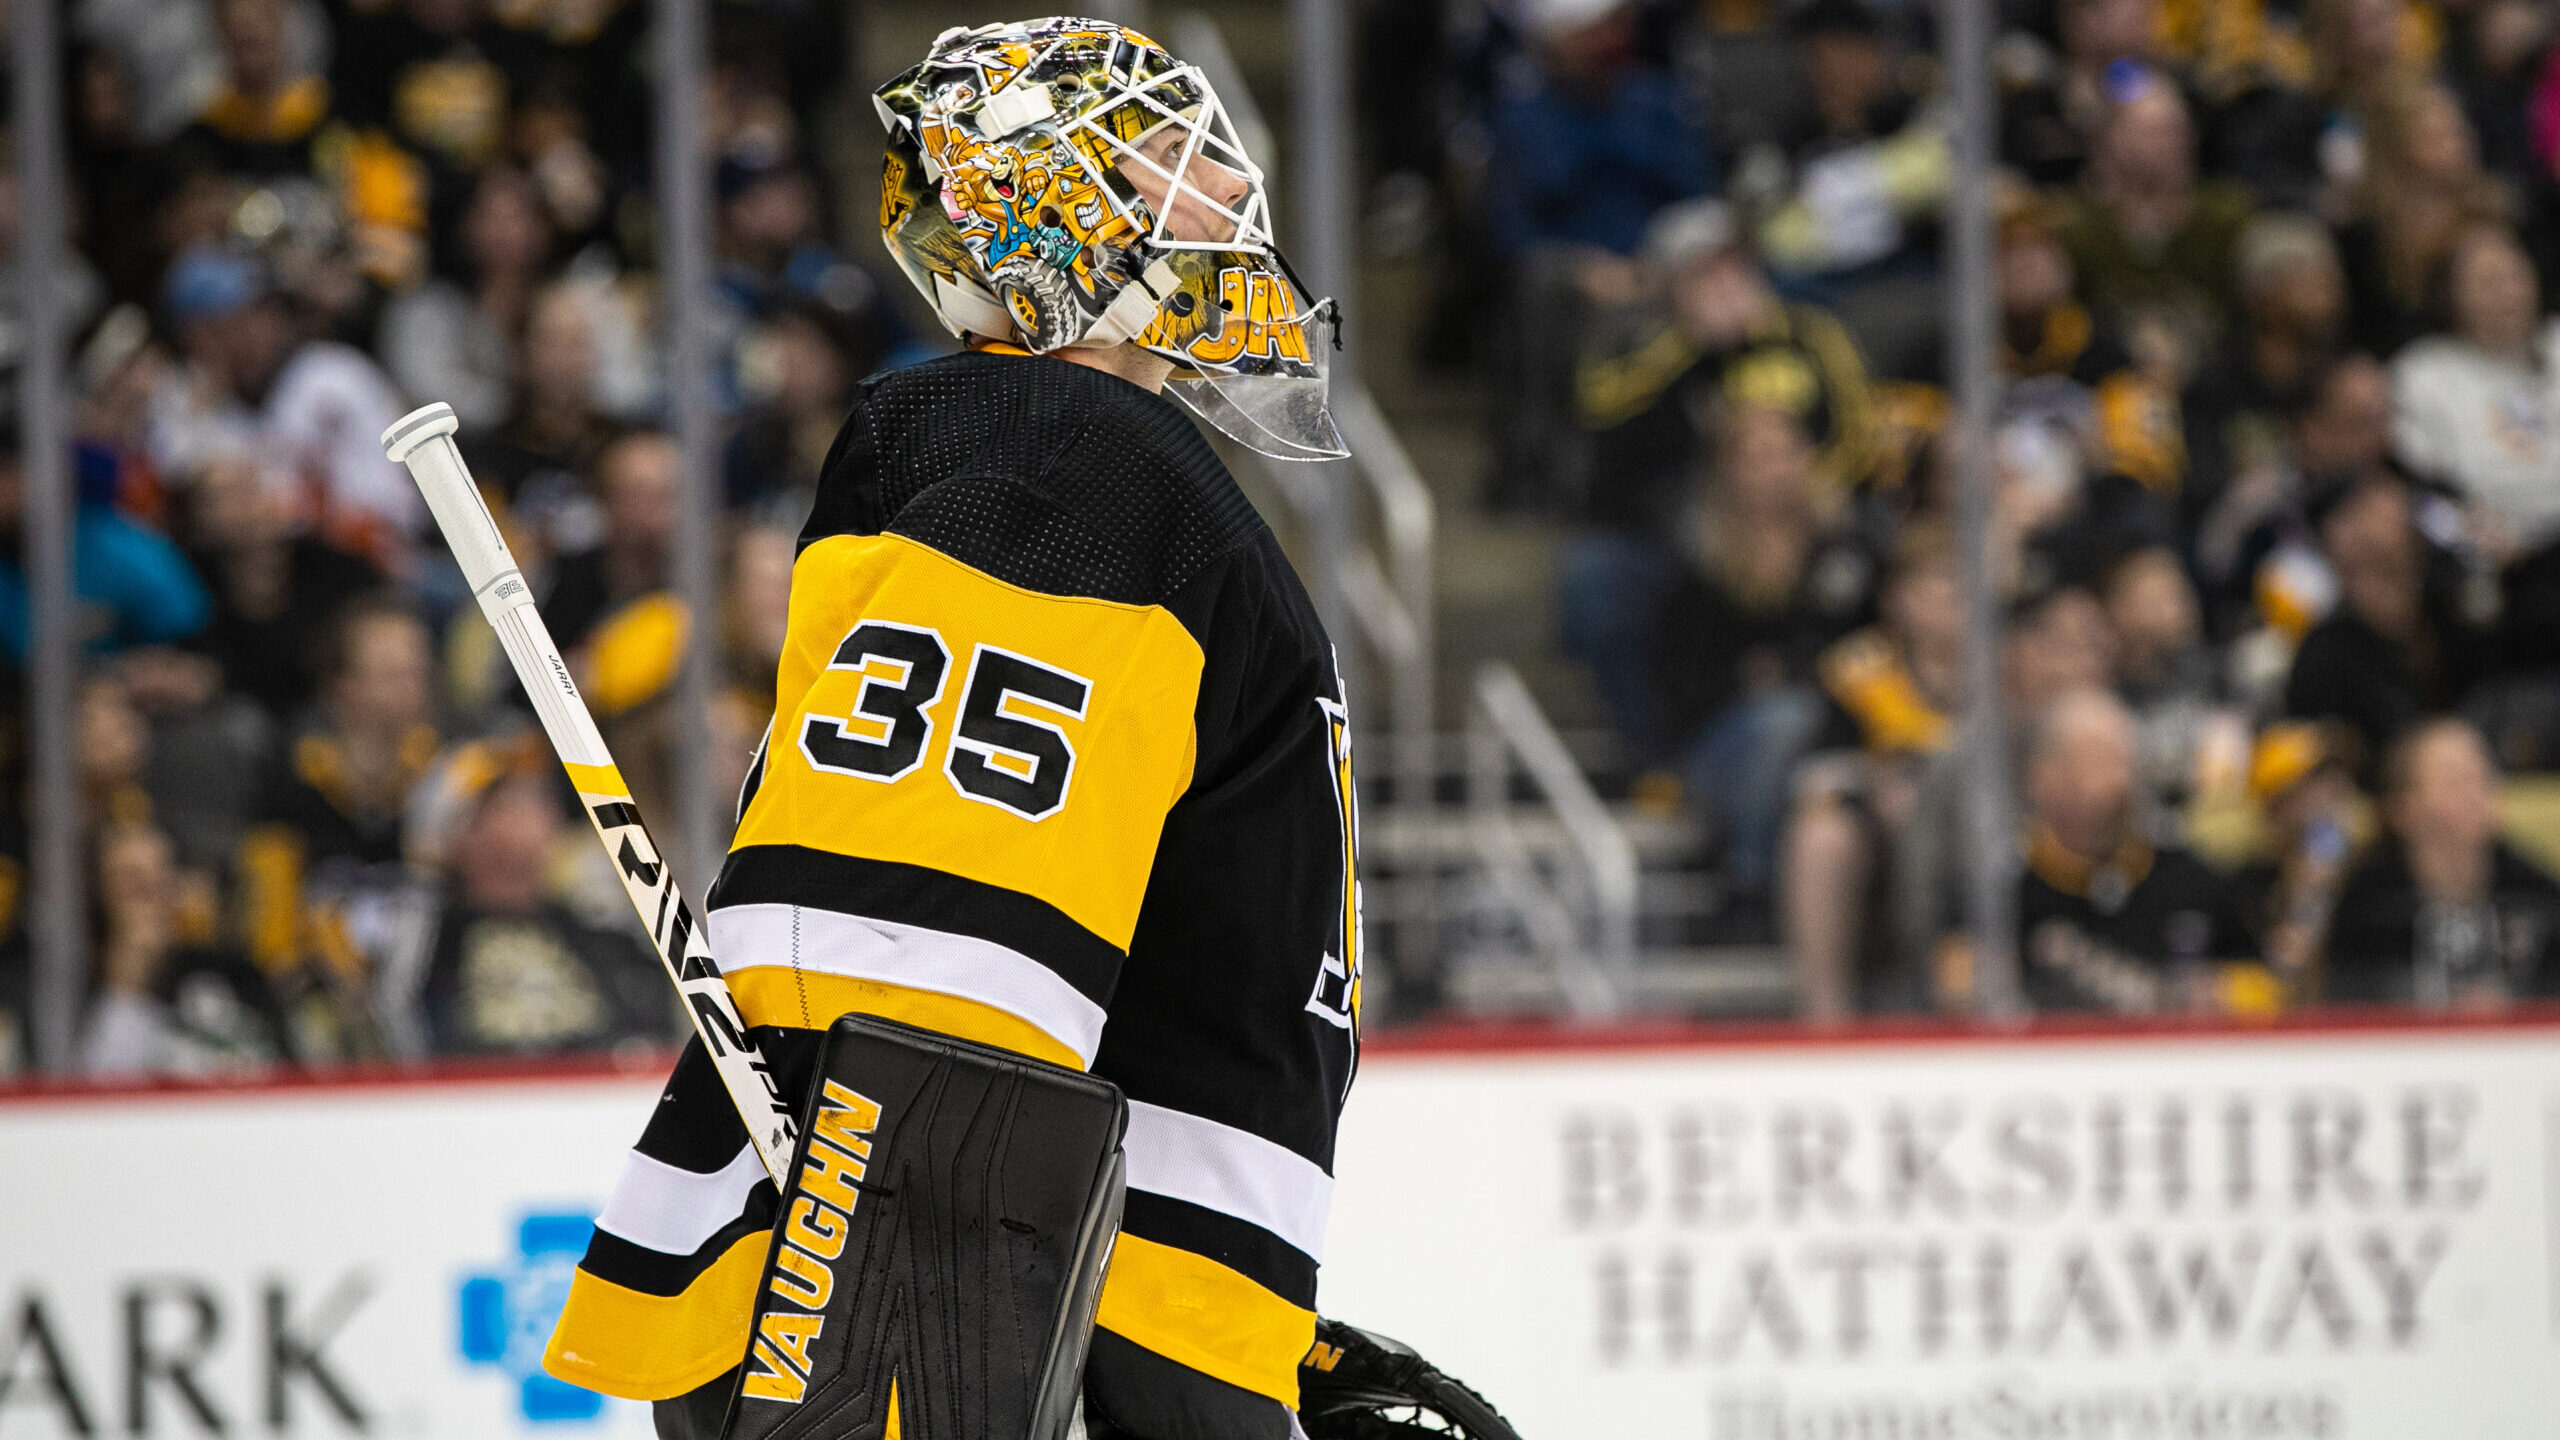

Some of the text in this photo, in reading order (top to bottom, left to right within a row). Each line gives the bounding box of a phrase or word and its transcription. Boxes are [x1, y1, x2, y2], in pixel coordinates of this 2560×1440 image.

[548, 654, 577, 699] JARRY
[797, 618, 1095, 823] 35
[1560, 1086, 2488, 1228] BERKSHIRE
[741, 1078, 882, 1404] VAUGHN
[1594, 1227, 2448, 1365] HATHAWAY
